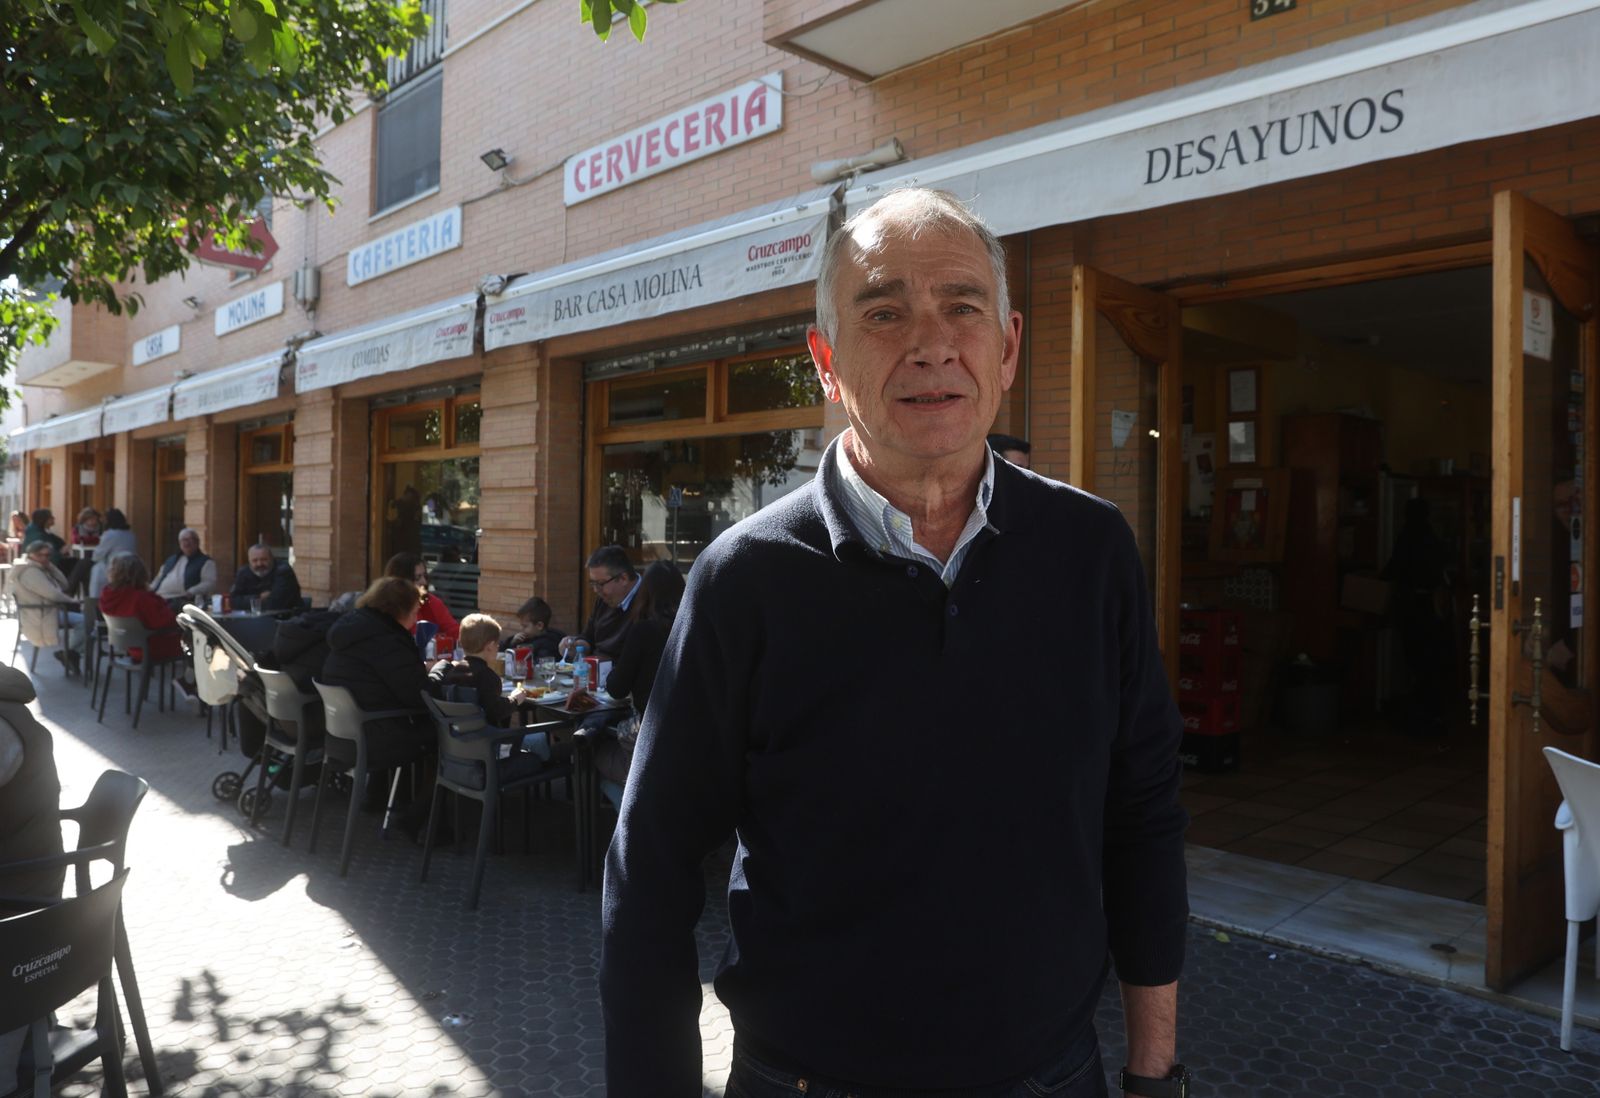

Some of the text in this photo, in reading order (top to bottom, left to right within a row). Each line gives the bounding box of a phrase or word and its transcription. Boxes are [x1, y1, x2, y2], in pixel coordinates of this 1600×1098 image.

[573, 84, 768, 193] CERVECERIA
[1143, 88, 1405, 186] DESAYUNOS
[352, 213, 453, 279] CAFETERIA
[747, 233, 812, 262] Cruzcampo
[227, 290, 266, 328] MOLINA
[553, 263, 704, 322] BAR CASA MOLINA
[12, 944, 72, 977] Cruzcampo
